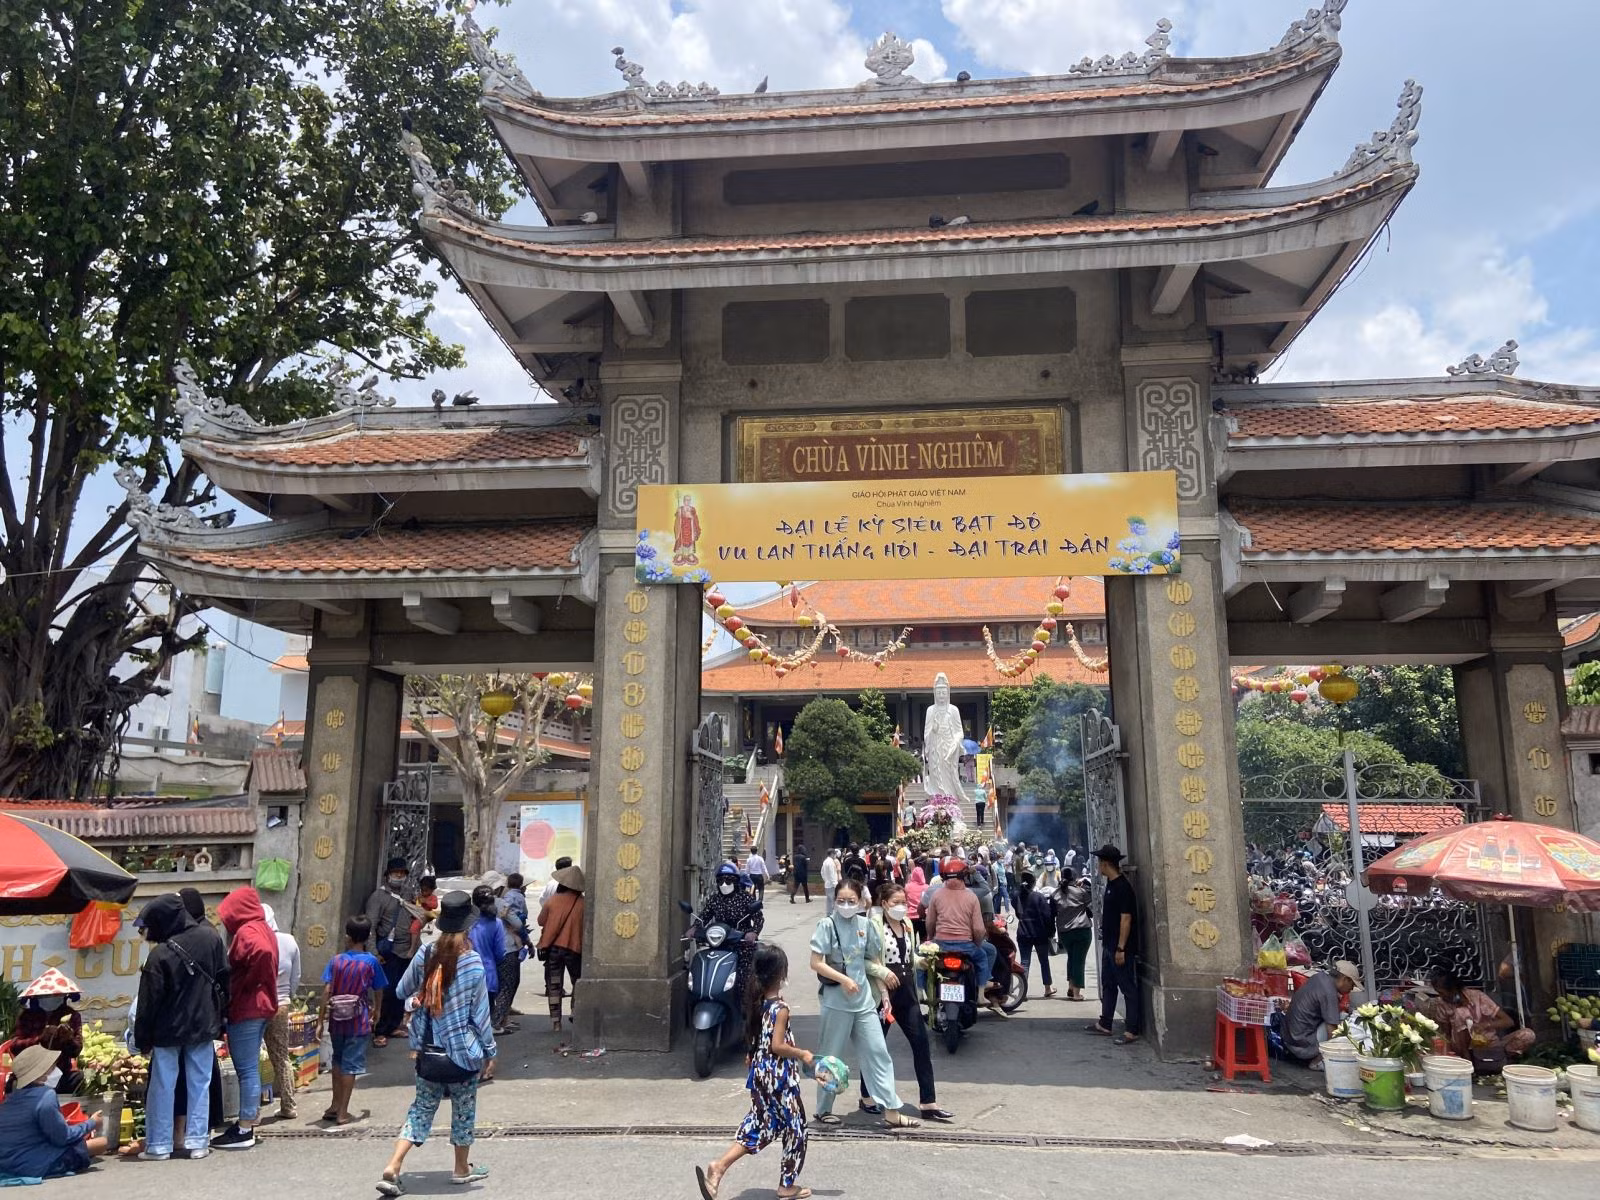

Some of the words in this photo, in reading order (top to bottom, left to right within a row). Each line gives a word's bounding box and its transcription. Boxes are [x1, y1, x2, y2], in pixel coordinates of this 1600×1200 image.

[793, 440, 849, 473] CHÙA
[852, 489, 871, 498] GIÁO
[909, 488, 928, 497] GIÁO
[776, 519, 815, 539] ĐẠI
[824, 515, 849, 534] LỄ
[858, 514, 884, 533] KỲ
[891, 515, 943, 534] SIÊU
[952, 514, 997, 535] BẠT
[1007, 512, 1041, 531] ĐỘ
[718, 545, 747, 562] VU
[757, 543, 795, 560] LAN
[802, 537, 874, 560] THẮNG
[884, 541, 918, 560] HỘI
[948, 540, 988, 560] ĐẠI
[995, 540, 1048, 557] TRAI
[1059, 533, 1109, 555] ĐÀN
